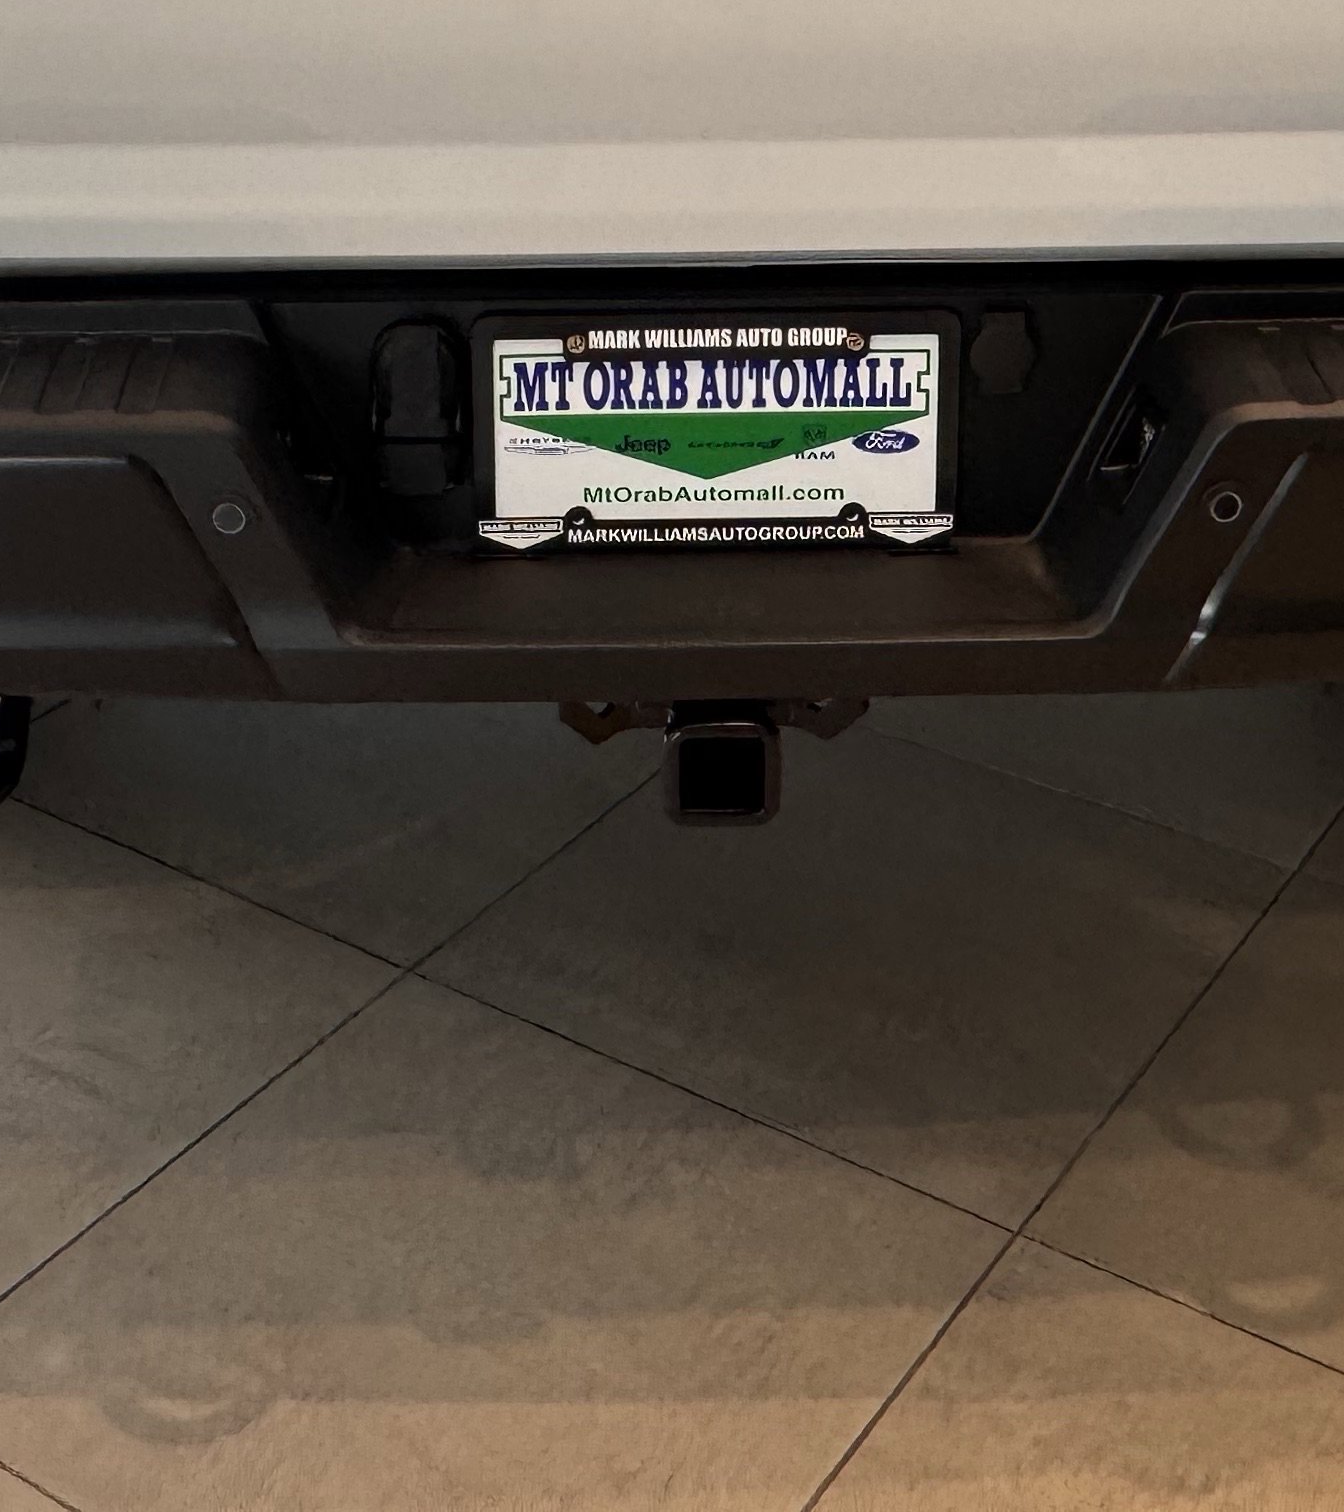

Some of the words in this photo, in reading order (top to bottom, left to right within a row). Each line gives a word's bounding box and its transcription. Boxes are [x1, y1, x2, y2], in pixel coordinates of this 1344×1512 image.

[588, 330, 640, 349] MARK
[645, 328, 731, 348] WILLIAMS
[736, 328, 783, 347] AUTO
[788, 327, 848, 347] GROUP
[513, 362, 574, 411] MT
[583, 360, 688, 410] ORAB
[697, 358, 912, 409] AUTOMALL
[615, 435, 671, 455] Jeep
[866, 432, 905, 449] Ford
[583, 485, 844, 503] MtOrabAutomall.com
[568, 525, 864, 543] MARKWILLIAMSAUTOGROUP.COM
